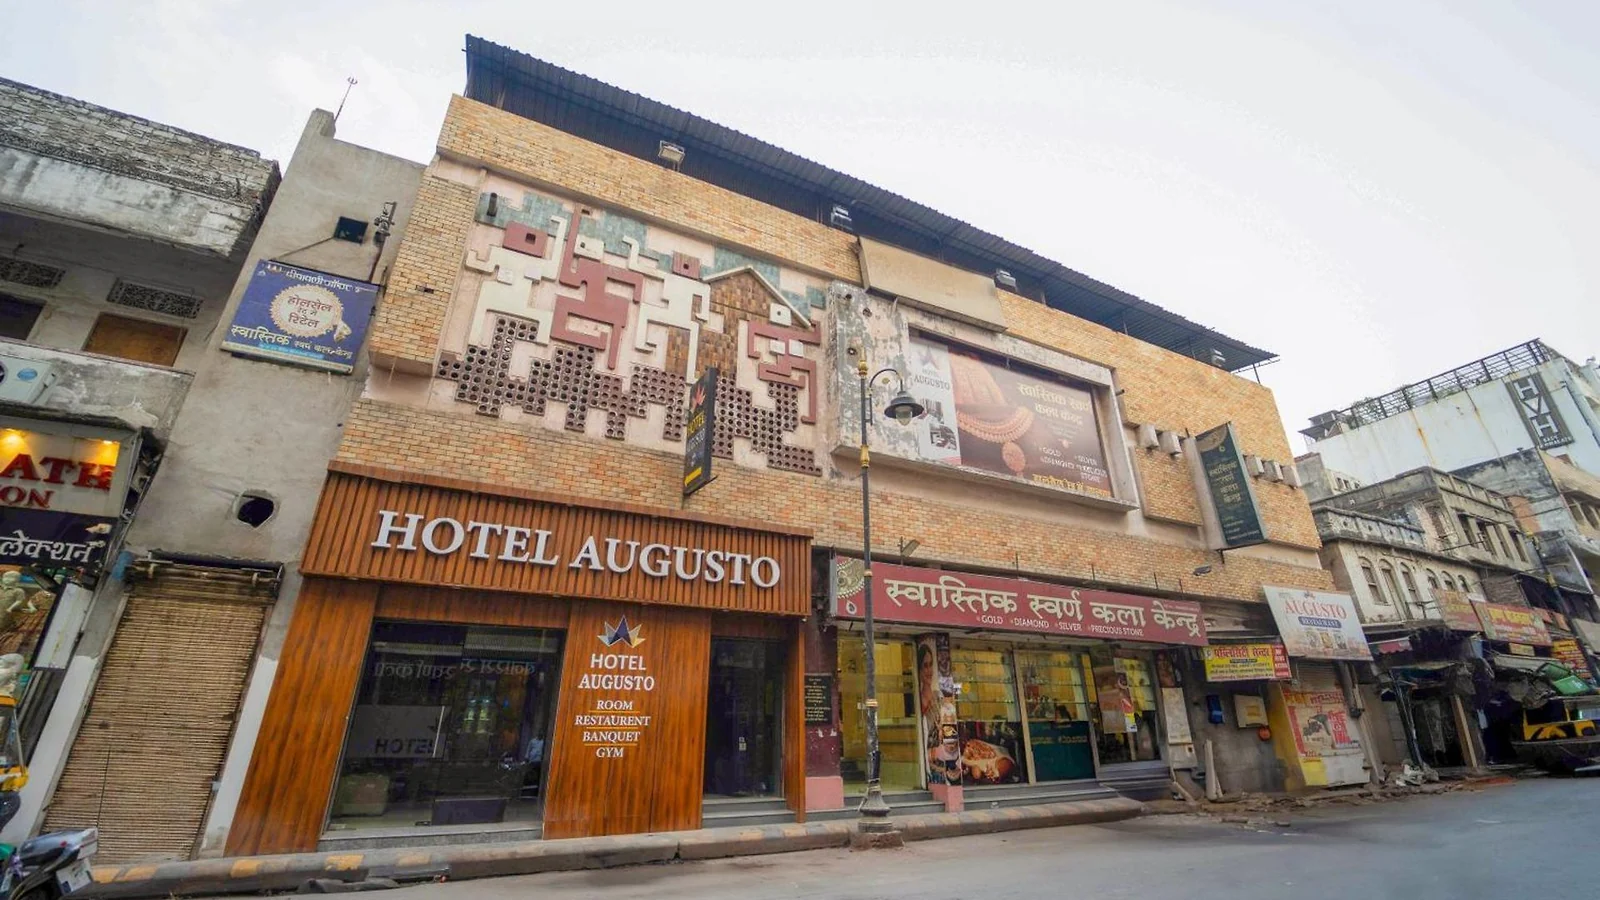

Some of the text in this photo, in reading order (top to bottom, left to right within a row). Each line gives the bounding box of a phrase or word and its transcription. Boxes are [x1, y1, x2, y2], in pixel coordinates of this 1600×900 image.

[288, 312, 319, 328] रिटेल
[231, 325, 292, 345] स्वास्तिक
[914, 374, 950, 391] AUGUSTO
[370, 510, 782, 589] HOTEL AUGUSTO
[884, 576, 1201, 638] स्वास्तिक स्वर्ण कला केन्द्र
[1285, 600, 1347, 620] AUGUSTO
[981, 615, 1144, 636] GOLD DIAMOND SILVER PRECIOUS STONE
[590, 653, 647, 671] HOTEL
[577, 673, 655, 691] AUGUSTO
[596, 699, 633, 711] ROOM
[574, 715, 651, 726] RESTAURENT
[582, 731, 641, 743] BANQUET
[596, 747, 624, 758] GYM
